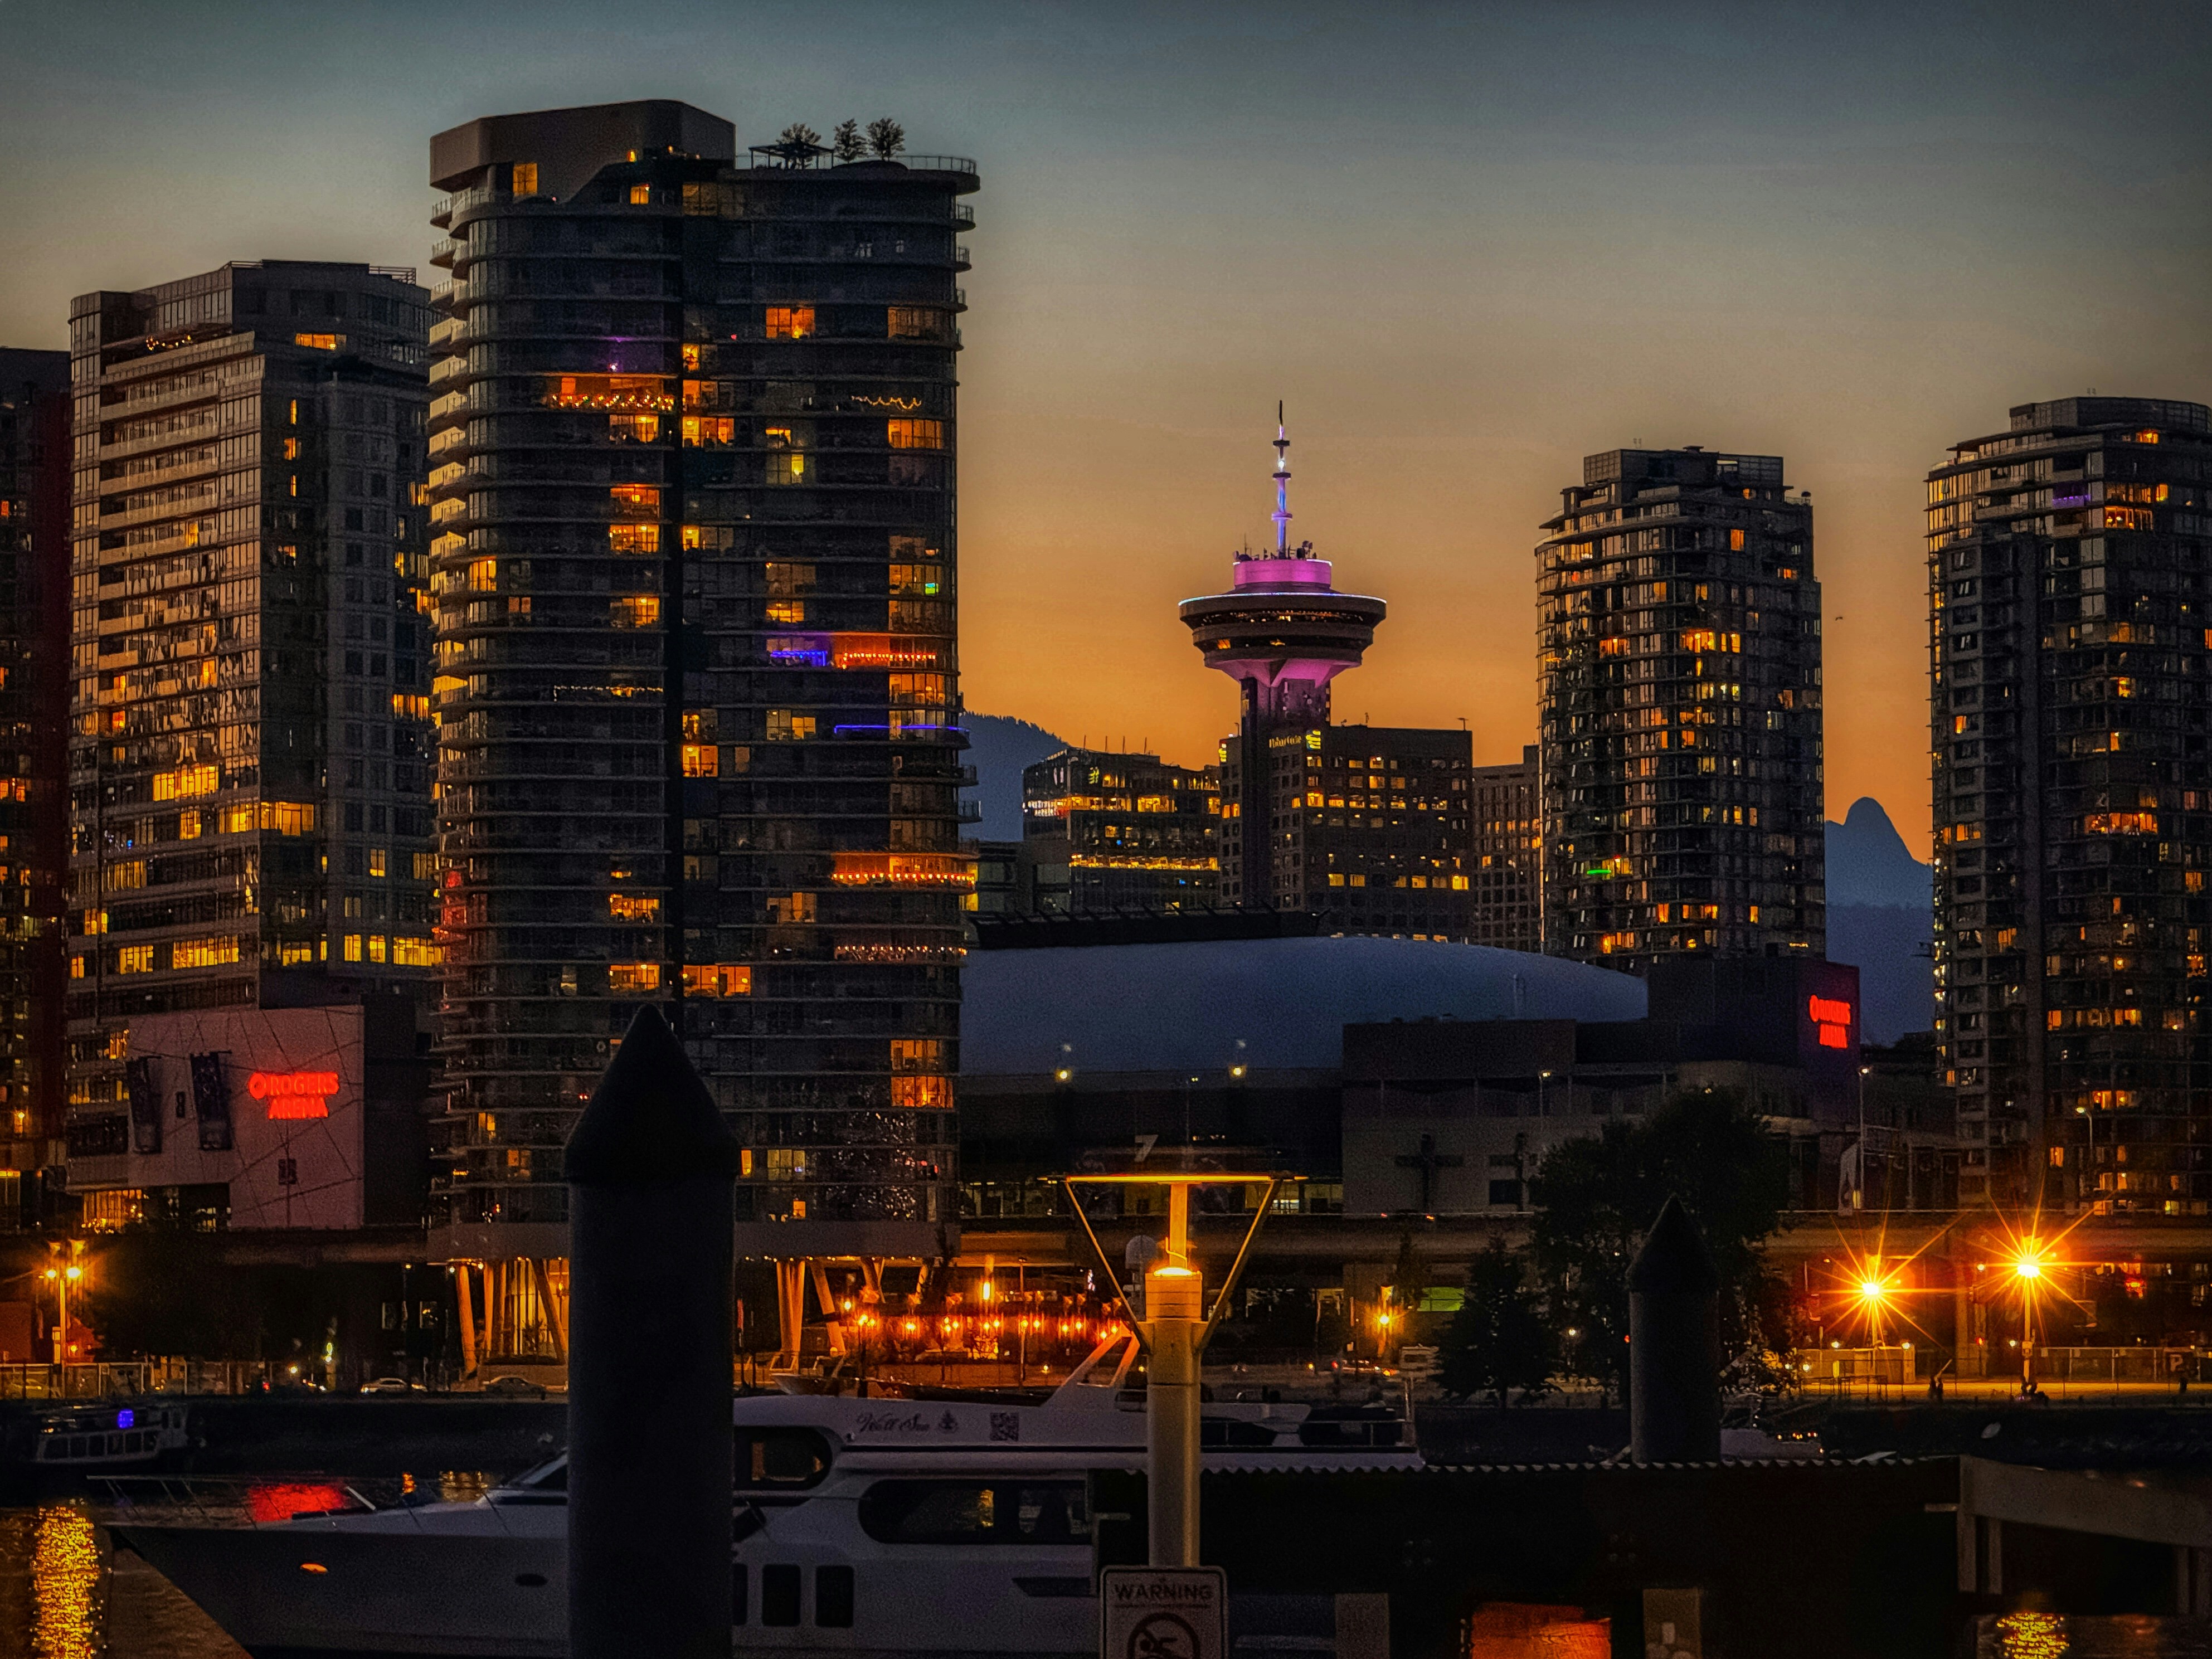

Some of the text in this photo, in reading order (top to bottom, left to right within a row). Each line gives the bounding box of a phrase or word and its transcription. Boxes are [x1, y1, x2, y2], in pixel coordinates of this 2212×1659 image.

[269, 1074, 339, 1095] ROGERS
[269, 1096, 329, 1120] ARENA
[1114, 1583, 1214, 1601] WARNING
